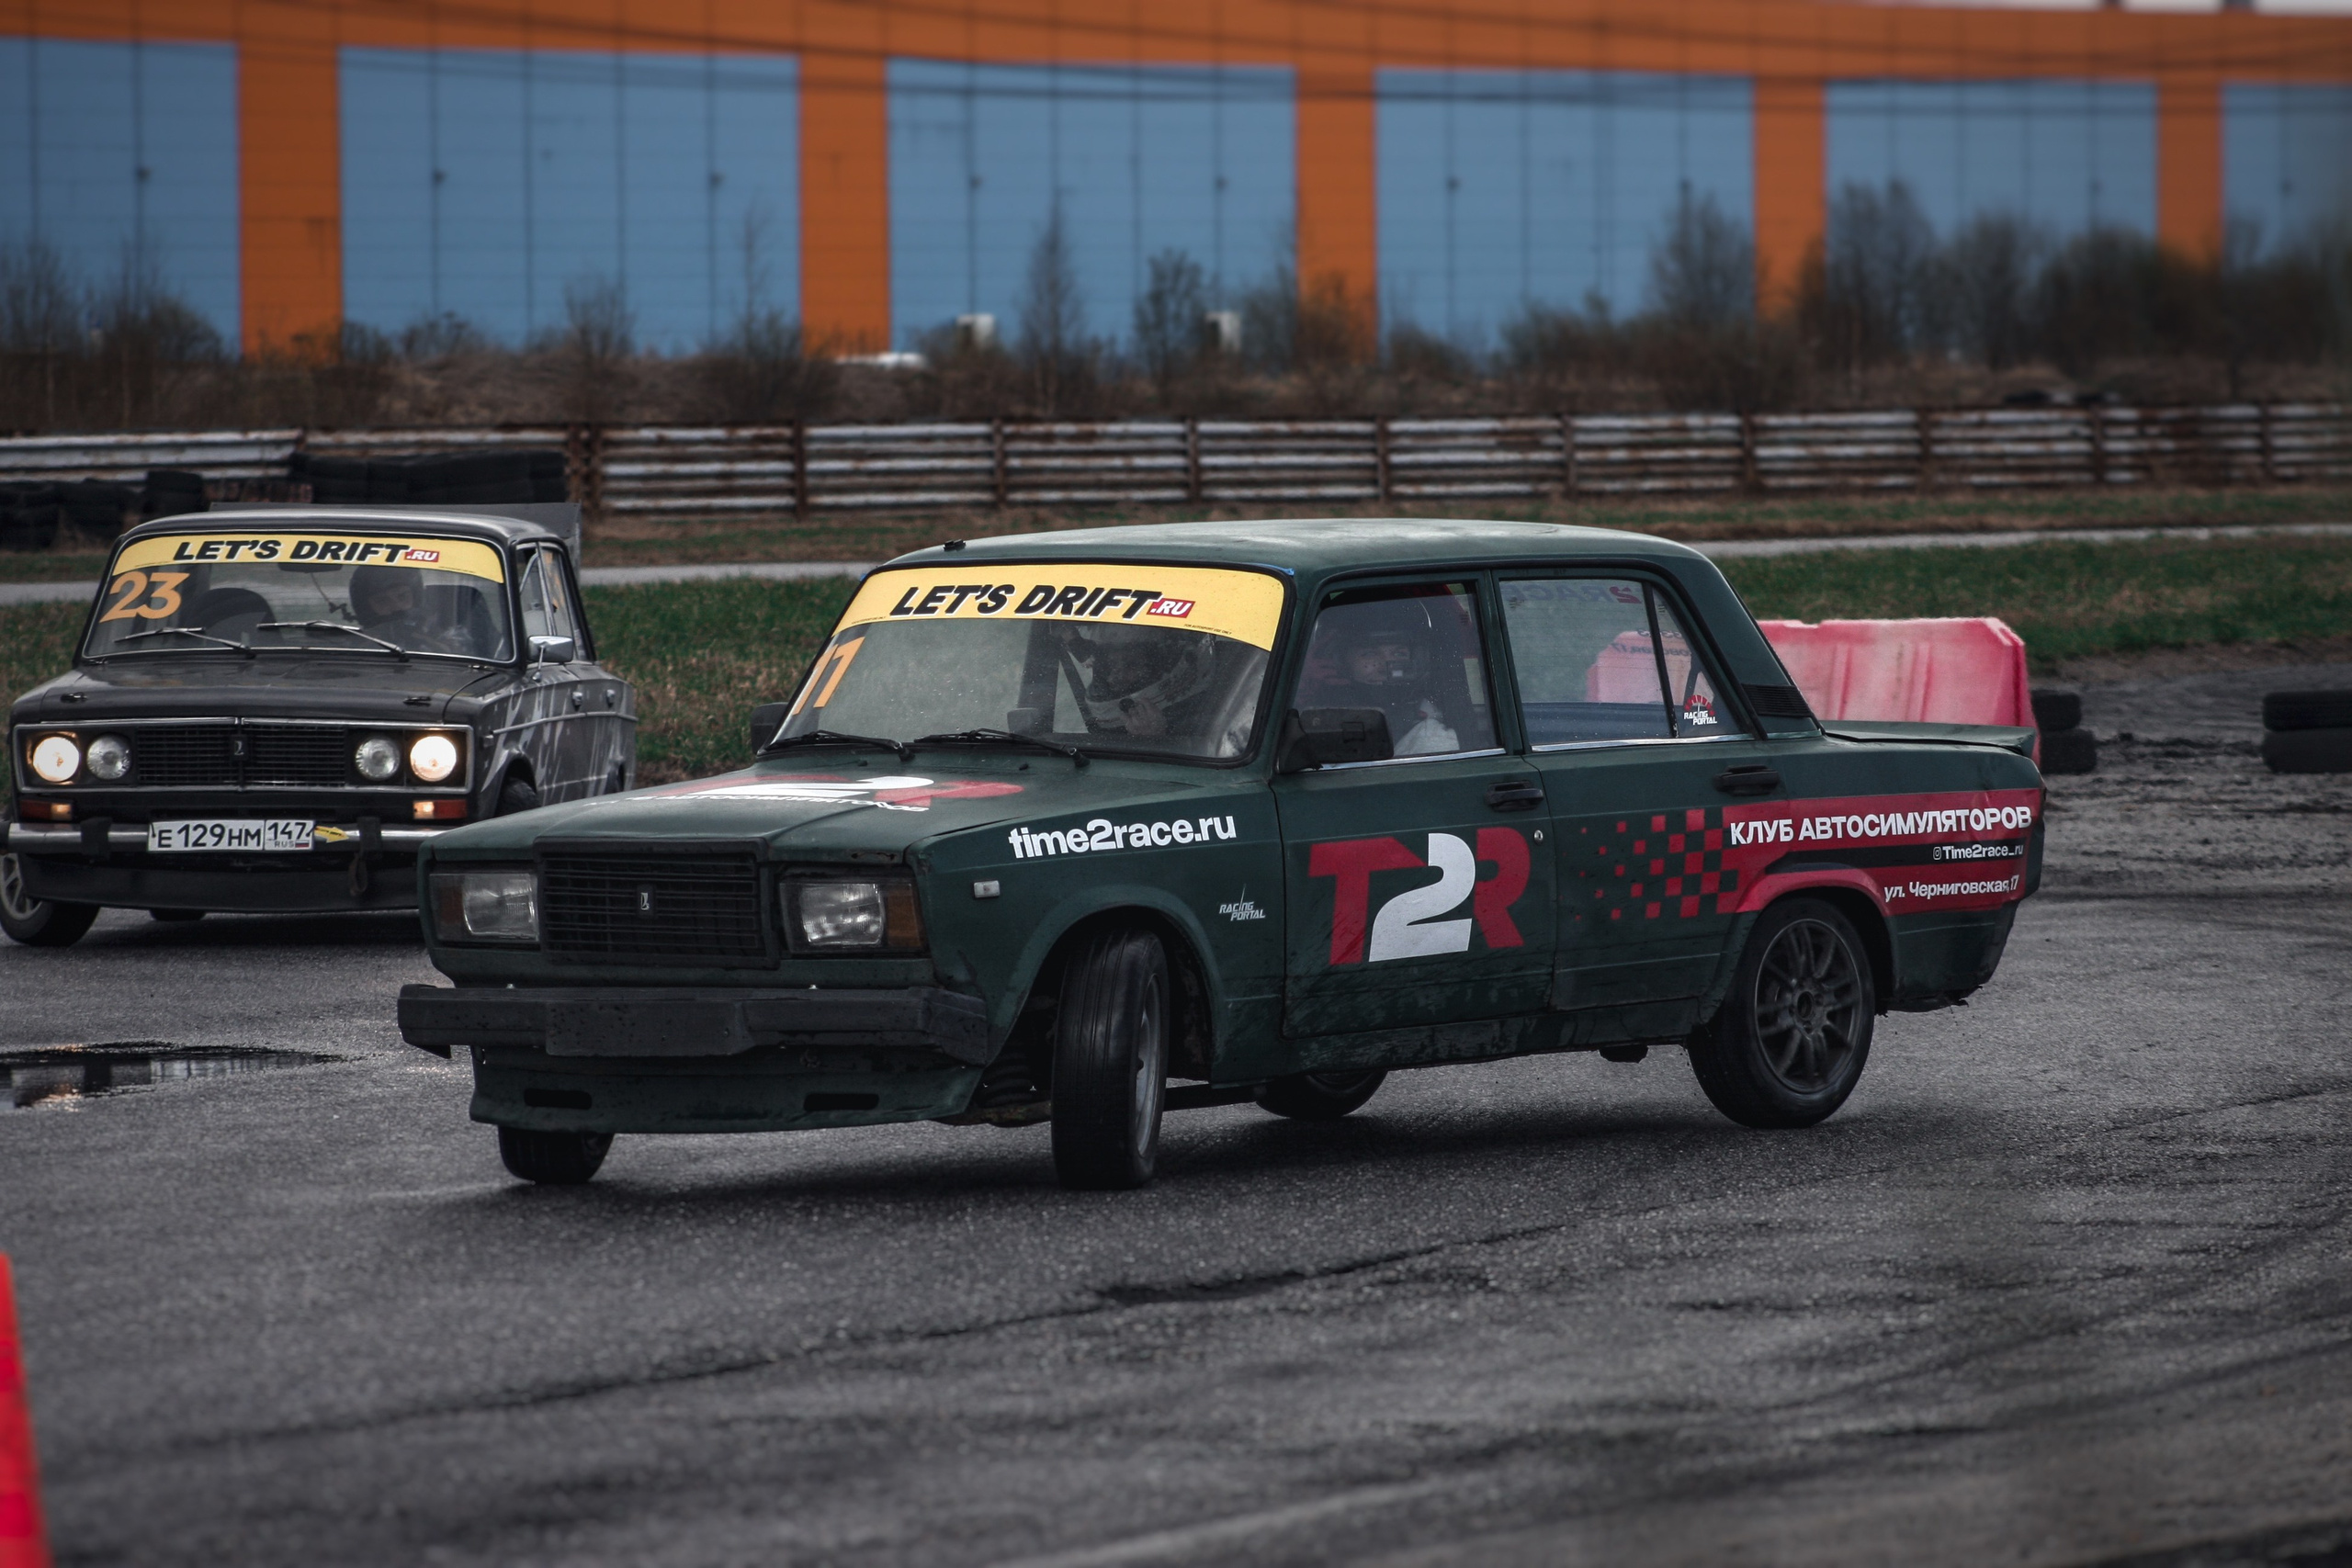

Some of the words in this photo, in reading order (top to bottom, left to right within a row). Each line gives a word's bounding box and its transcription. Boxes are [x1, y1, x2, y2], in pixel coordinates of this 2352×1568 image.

[173, 540, 281, 562] LET'S
[98, 571, 190, 623] 23
[889, 584, 1015, 616] LET'S
[1683, 710, 1709, 720] RACING
[1692, 716, 1717, 725] PORTAL
[1730, 818, 1794, 845] КЛУБ
[1798, 807, 2033, 841] АВТОСИМУЛЯТОРОВ
[274, 840, 295, 848] RUS
[1008, 815, 1237, 859] time2race.ru
[1307, 827, 1531, 964] T2R
[1883, 886, 1905, 903] ул.
[1218, 900, 1255, 914] RACING
[1230, 908, 1266, 921] PORTAL
